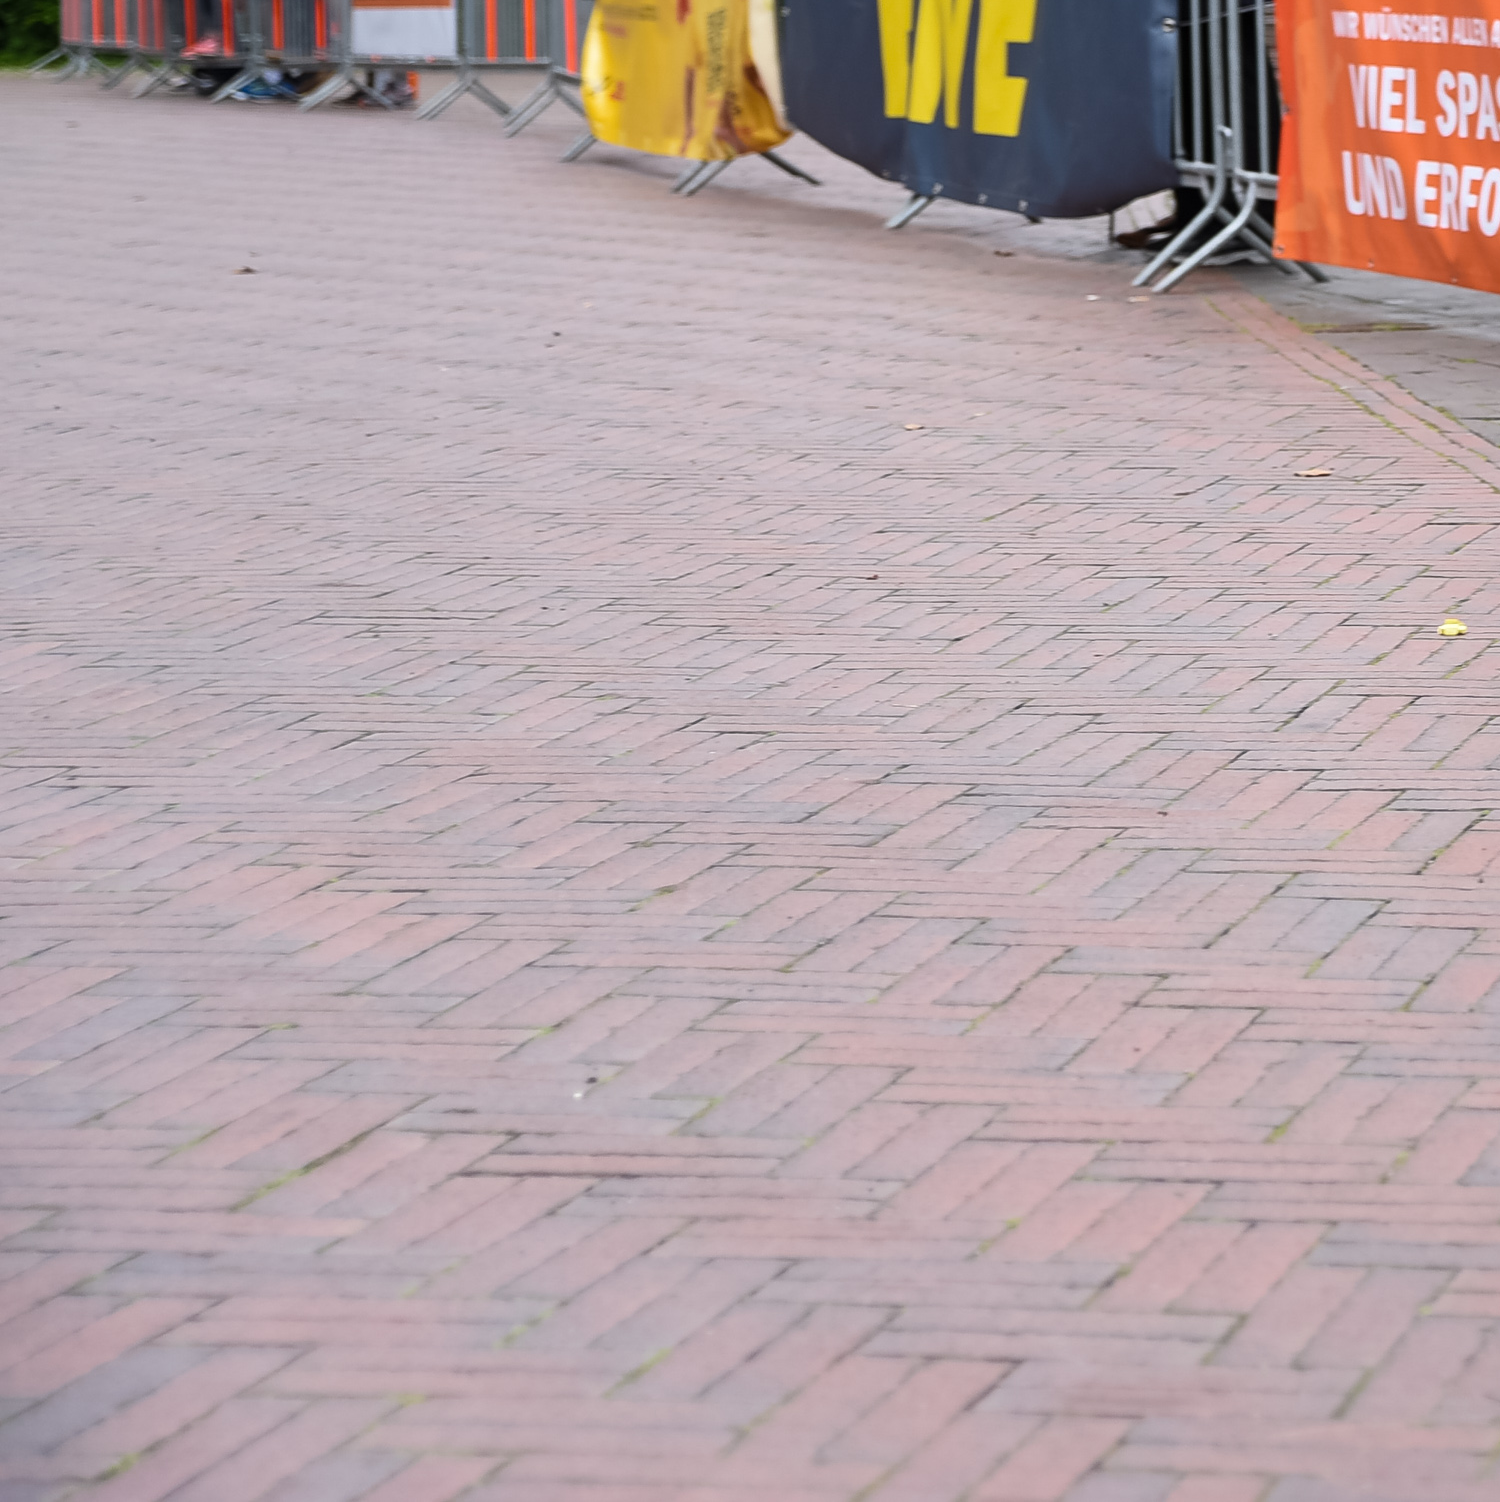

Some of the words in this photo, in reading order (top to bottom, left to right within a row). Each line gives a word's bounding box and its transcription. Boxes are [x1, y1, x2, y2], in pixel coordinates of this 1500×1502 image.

[1362, 5, 1450, 45] WÜNSCHEN
[1348, 64, 1426, 135] VIEL
[1341, 149, 1408, 222] UND
